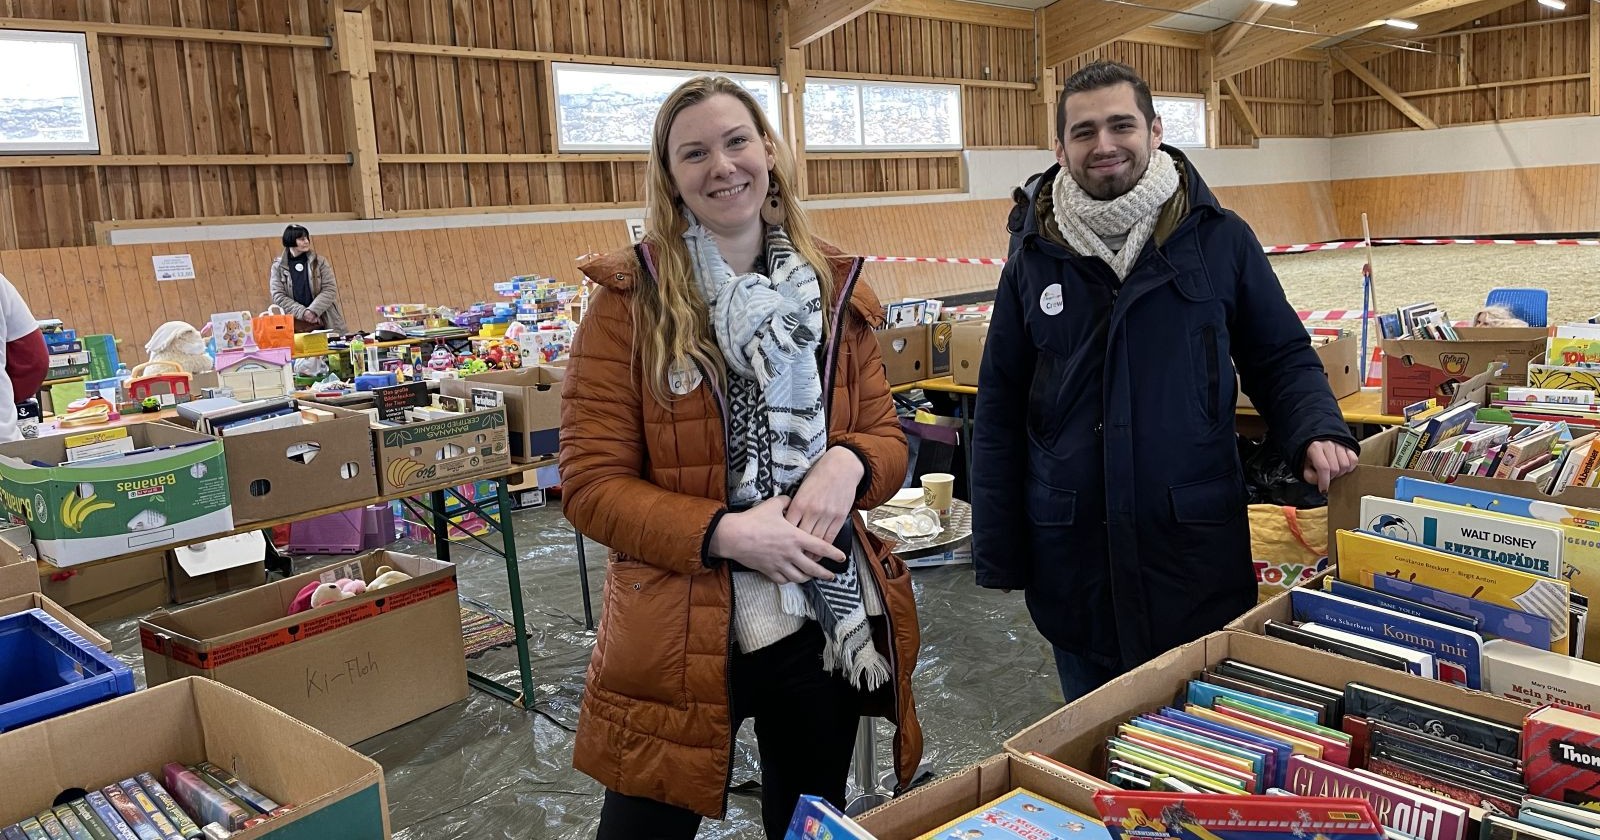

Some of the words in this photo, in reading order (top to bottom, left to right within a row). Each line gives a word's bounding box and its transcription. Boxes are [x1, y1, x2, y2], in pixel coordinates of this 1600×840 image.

[414, 423, 445, 434] ORGANIC
[426, 424, 469, 438] BANANAS
[447, 416, 480, 428] CERTIFIED
[1418, 432, 1431, 450] Atlas
[416, 464, 436, 480] Bio
[1578, 449, 1600, 484] Abenteuer
[116, 473, 177, 492] Bananas
[1461, 527, 1492, 541] WALT
[1493, 533, 1537, 550] DISNEY
[1444, 541, 1550, 573] ENZYKLOPÄDIE
[1252, 561, 1317, 588] Toys
[1458, 571, 1475, 581] Birgit
[1475, 574, 1497, 585] Antoni
[1325, 614, 1338, 623] Eva
[1338, 617, 1375, 633] Scherbarth
[1383, 623, 1436, 650] Komm
[1440, 641, 1468, 658] mit
[1531, 680, 1546, 690] Mary
[1511, 683, 1543, 700] Mein
[1545, 692, 1592, 712] Freund
